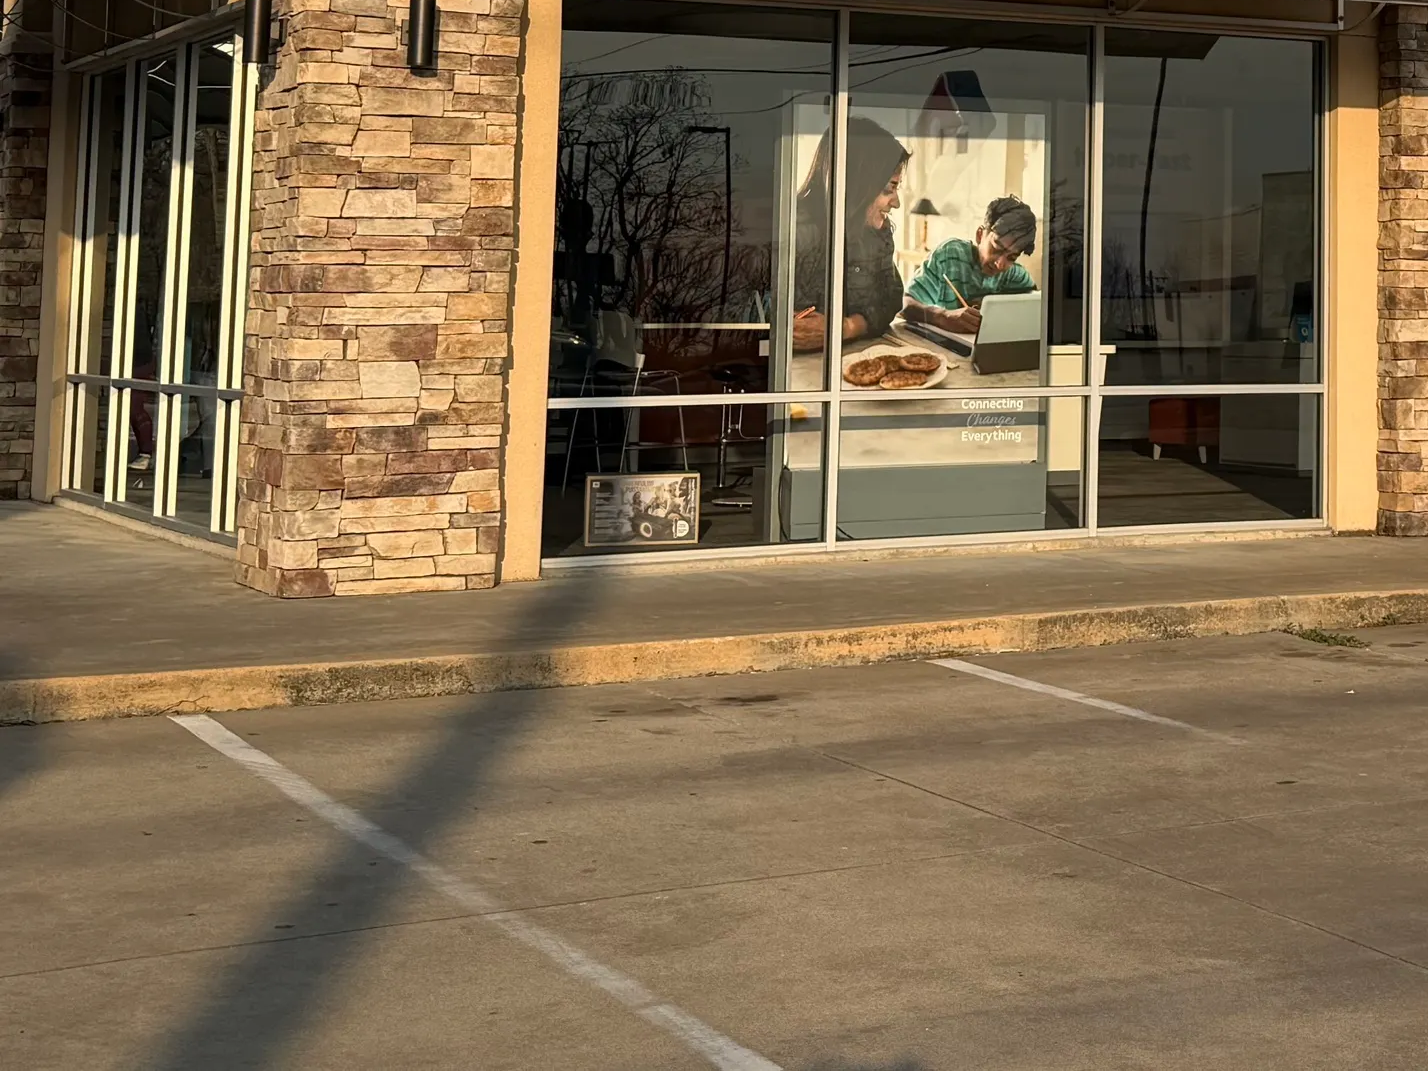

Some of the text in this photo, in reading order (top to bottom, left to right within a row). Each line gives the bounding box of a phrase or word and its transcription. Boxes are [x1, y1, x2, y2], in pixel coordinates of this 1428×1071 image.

[961, 398, 1024, 411] Connecting
[966, 413, 1017, 429] Changes
[961, 429, 1022, 444] Everything
